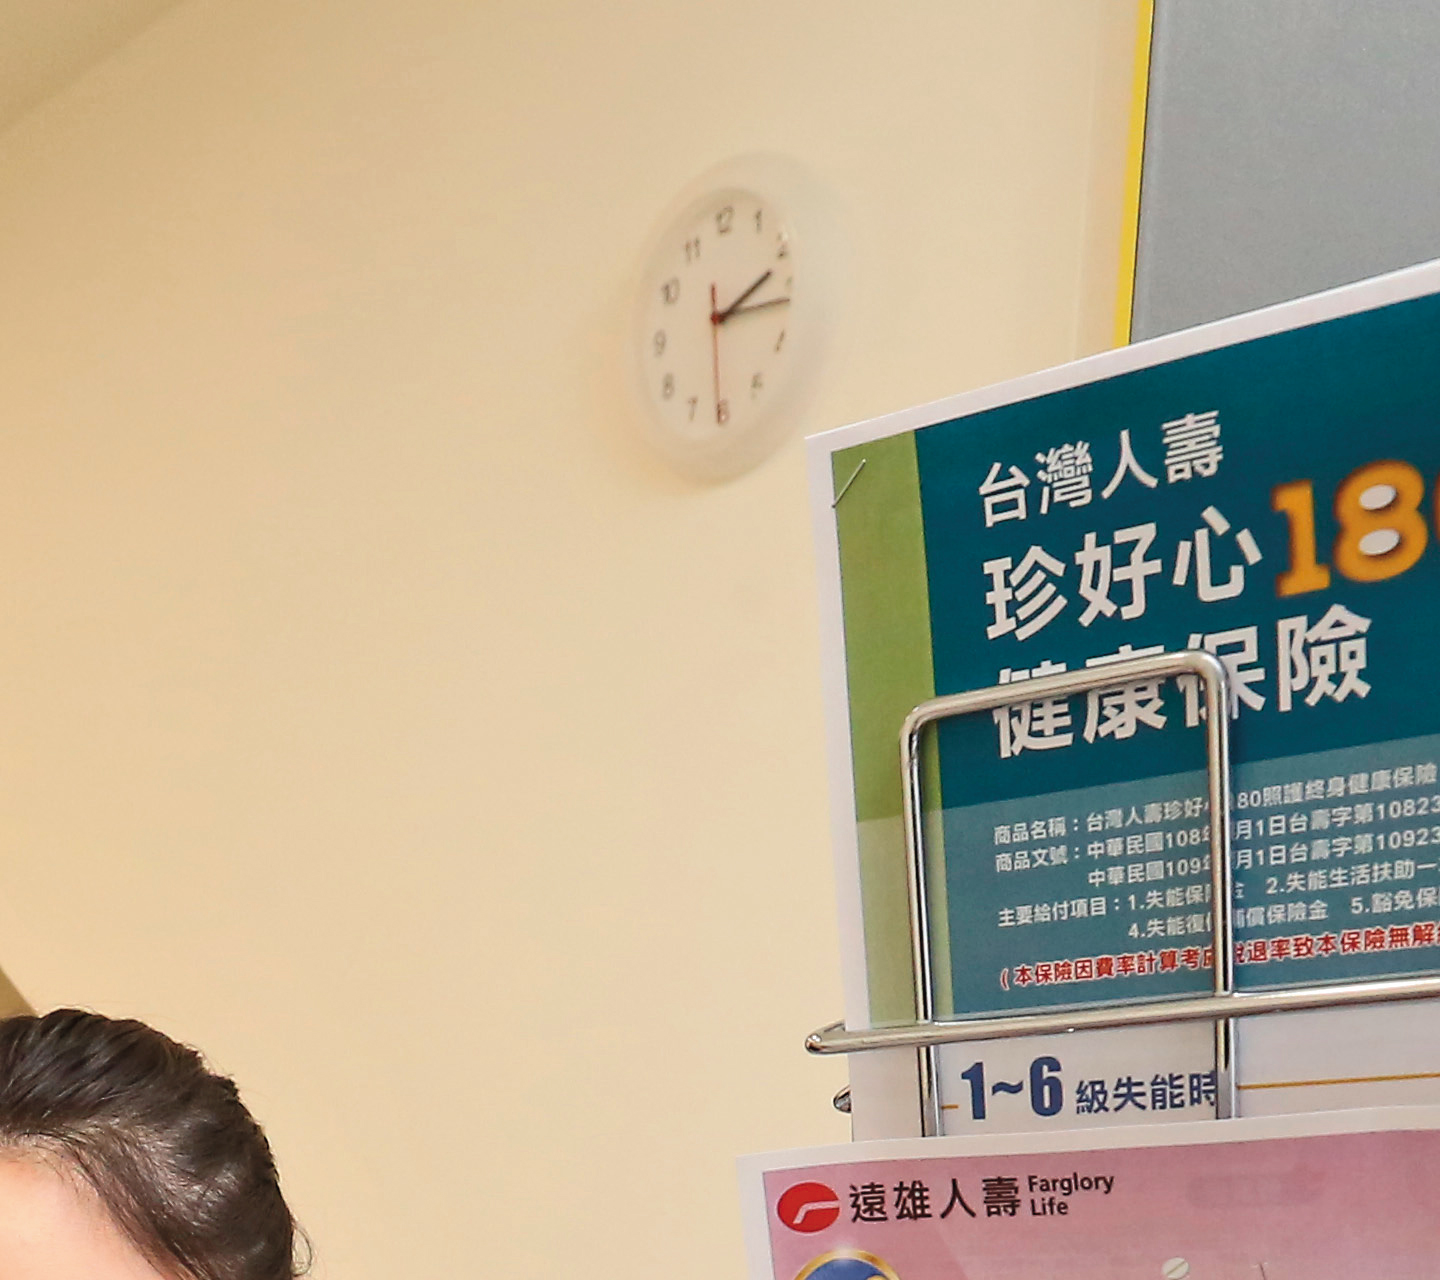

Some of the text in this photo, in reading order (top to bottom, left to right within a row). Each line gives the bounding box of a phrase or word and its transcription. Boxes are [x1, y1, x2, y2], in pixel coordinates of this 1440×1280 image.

[979, 410, 1223, 530] 台灣人壽
[992, 604, 1375, 758] 健康保險
[961, 1055, 1217, 1120] 1~6 級失能時
[850, 1171, 1114, 1224] 遠雄人壽 Farglory
[1030, 1196, 1069, 1217] Life
